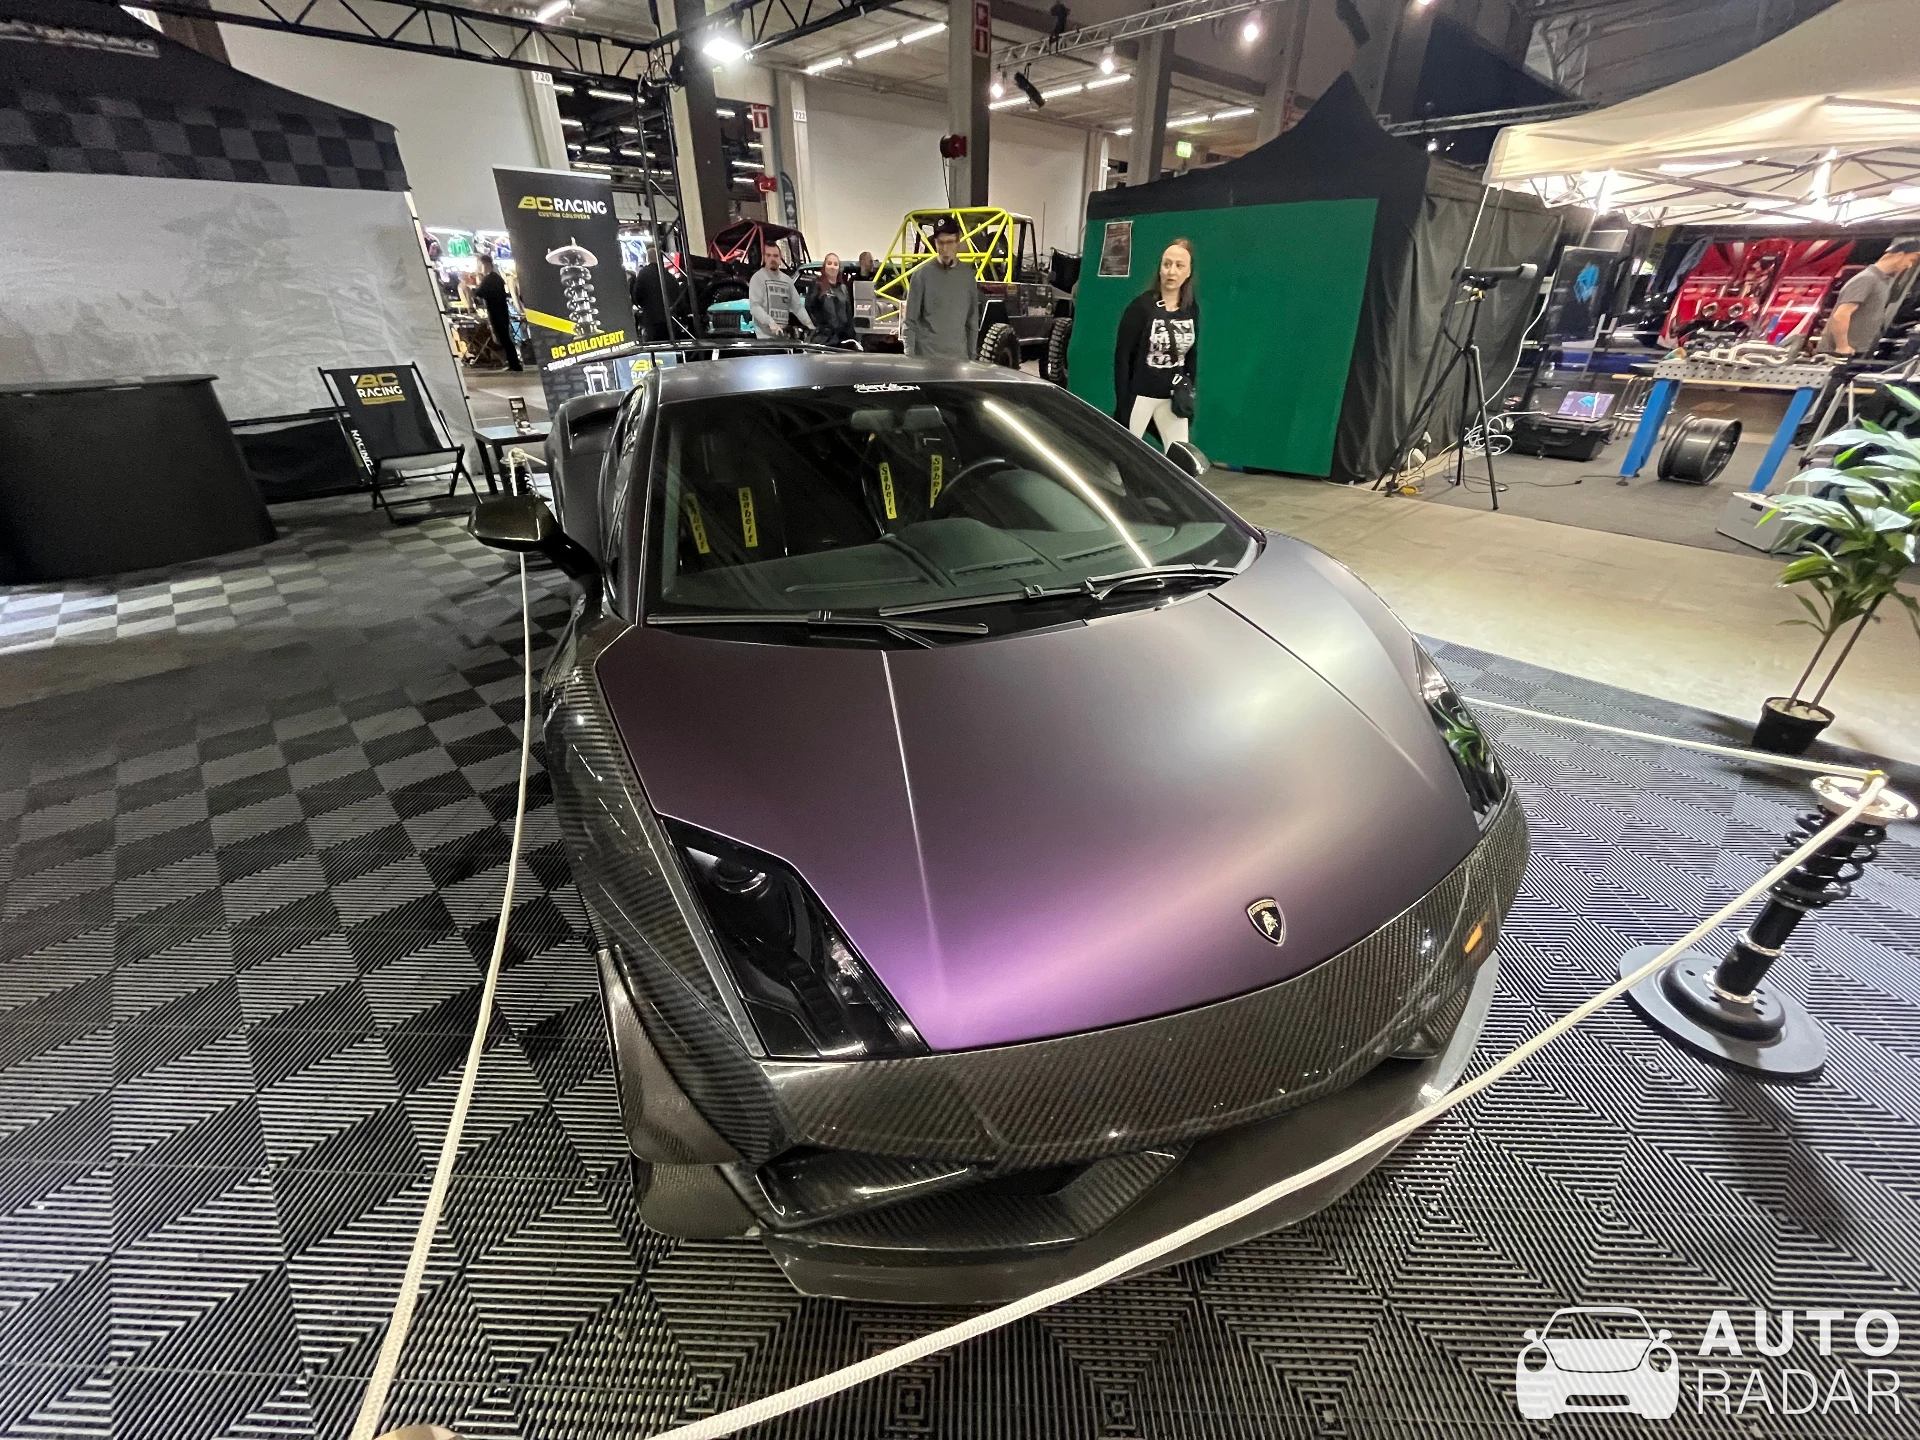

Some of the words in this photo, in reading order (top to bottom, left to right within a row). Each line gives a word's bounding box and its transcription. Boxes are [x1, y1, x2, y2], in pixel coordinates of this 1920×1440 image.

[534, 71, 551, 83] 720
[550, 345, 567, 360] BC
[567, 330, 626, 356] COILOVERIT
[355, 372, 399, 388] BC
[356, 385, 403, 399] RACING
[880, 465, 894, 516] Sabelt
[740, 490, 754, 544] Sabelt
